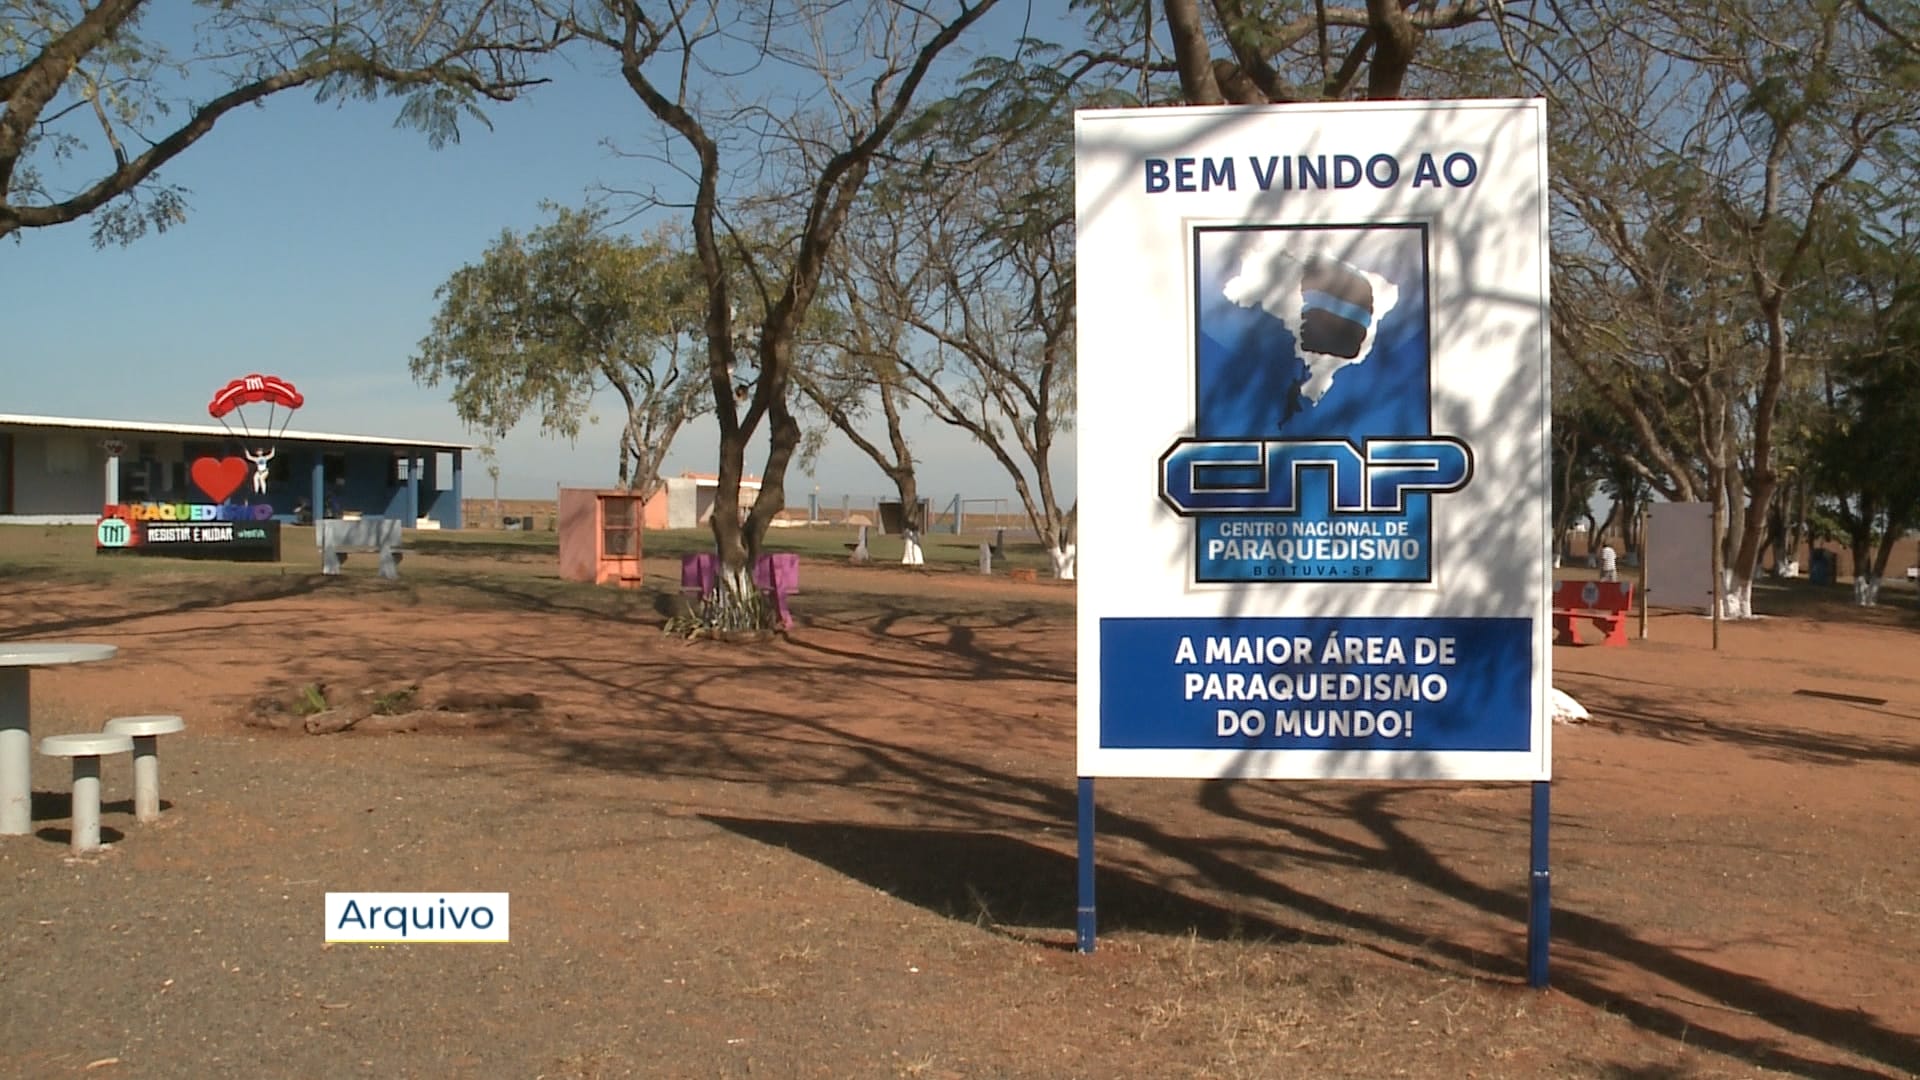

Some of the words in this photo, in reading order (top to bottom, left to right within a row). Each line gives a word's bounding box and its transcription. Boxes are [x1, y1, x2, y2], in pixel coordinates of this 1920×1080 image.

[1145, 156, 1237, 193] BEM
[1249, 153, 1400, 191] VINDO
[1412, 152, 1478, 188] AO
[102, 503, 274, 521] PARAQUEDISMO
[101, 525, 127, 543] TNT
[148, 527, 190, 542] RESISTIR
[202, 527, 233, 541] MUDAR
[1220, 521, 1288, 537] CENTRO
[1292, 521, 1382, 537] NACIONAL
[1385, 521, 1409, 537] DE
[1208, 539, 1420, 563] PARAQUEDISMO
[1253, 565, 1375, 577] BOITUVA-SP
[1175, 636, 1198, 664] A
[1205, 636, 1313, 664] MAIOR
[1321, 631, 1406, 664] ÁREA
[1415, 636, 1456, 664] DE
[1184, 673, 1447, 701] PARAQUEDISMO
[1217, 709, 1266, 737] DO
[1274, 709, 1413, 737] MUNDO!
